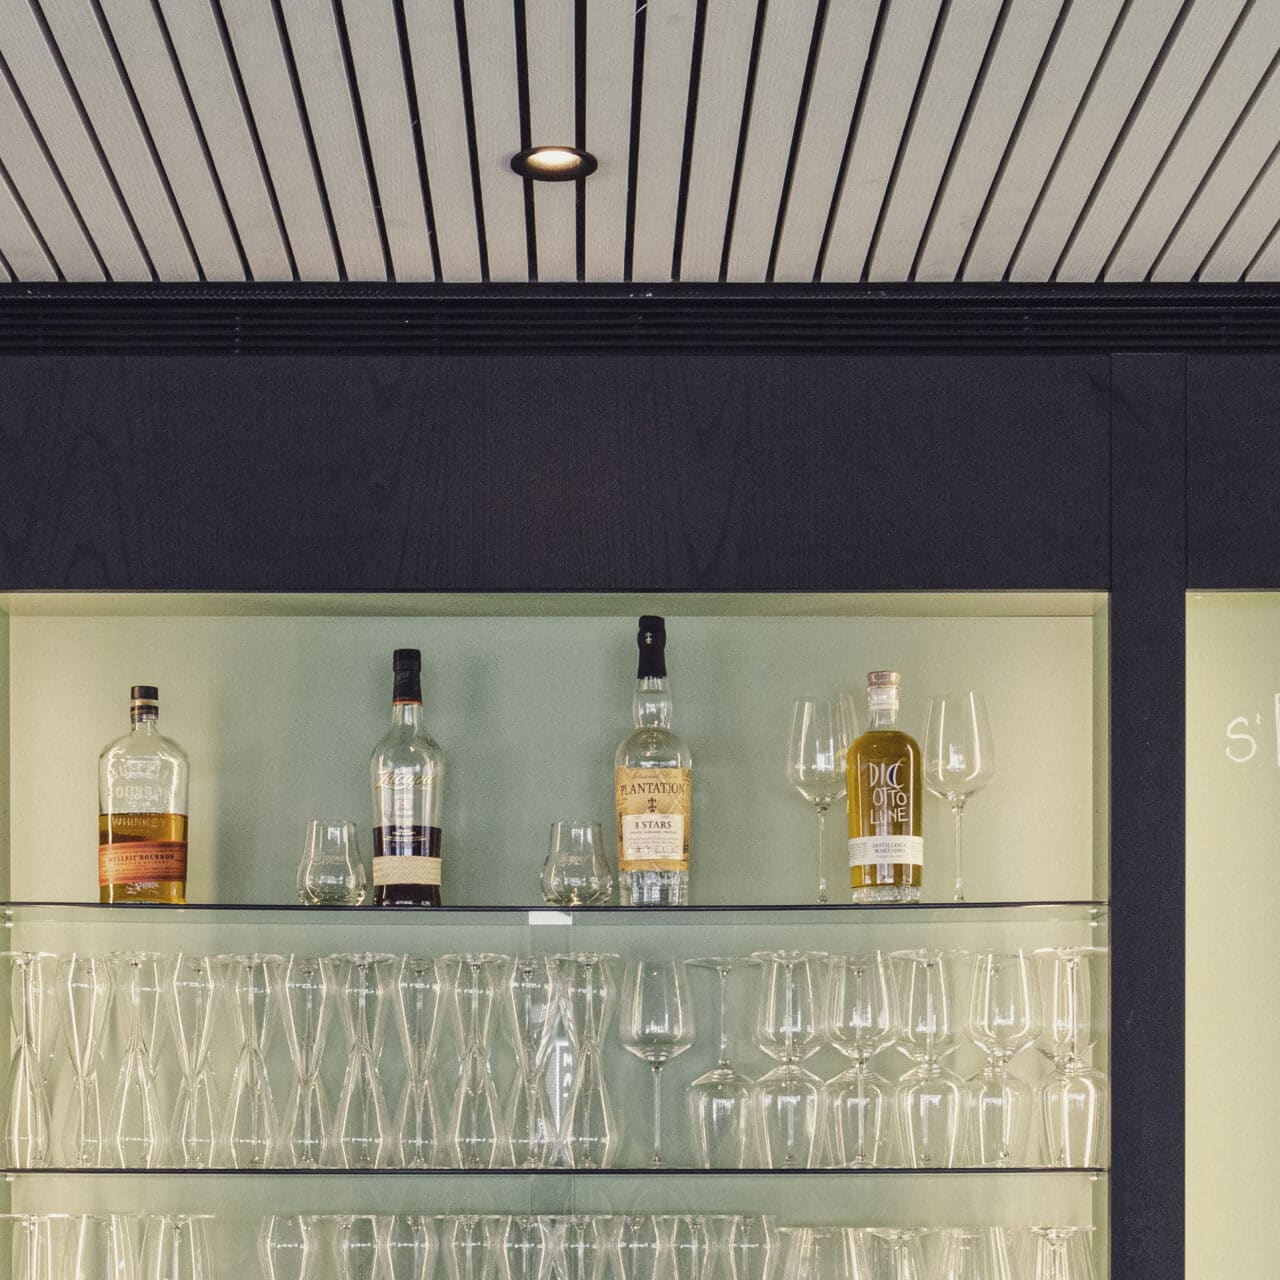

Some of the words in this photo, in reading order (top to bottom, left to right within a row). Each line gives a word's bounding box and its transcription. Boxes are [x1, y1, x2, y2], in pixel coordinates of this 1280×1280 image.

[620, 781, 686, 797] PLANTATION
[872, 785, 908, 809] OTTO
[633, 820, 640, 830] 3
[641, 820, 673, 829] STARS
[869, 806, 909, 826] LUNE
